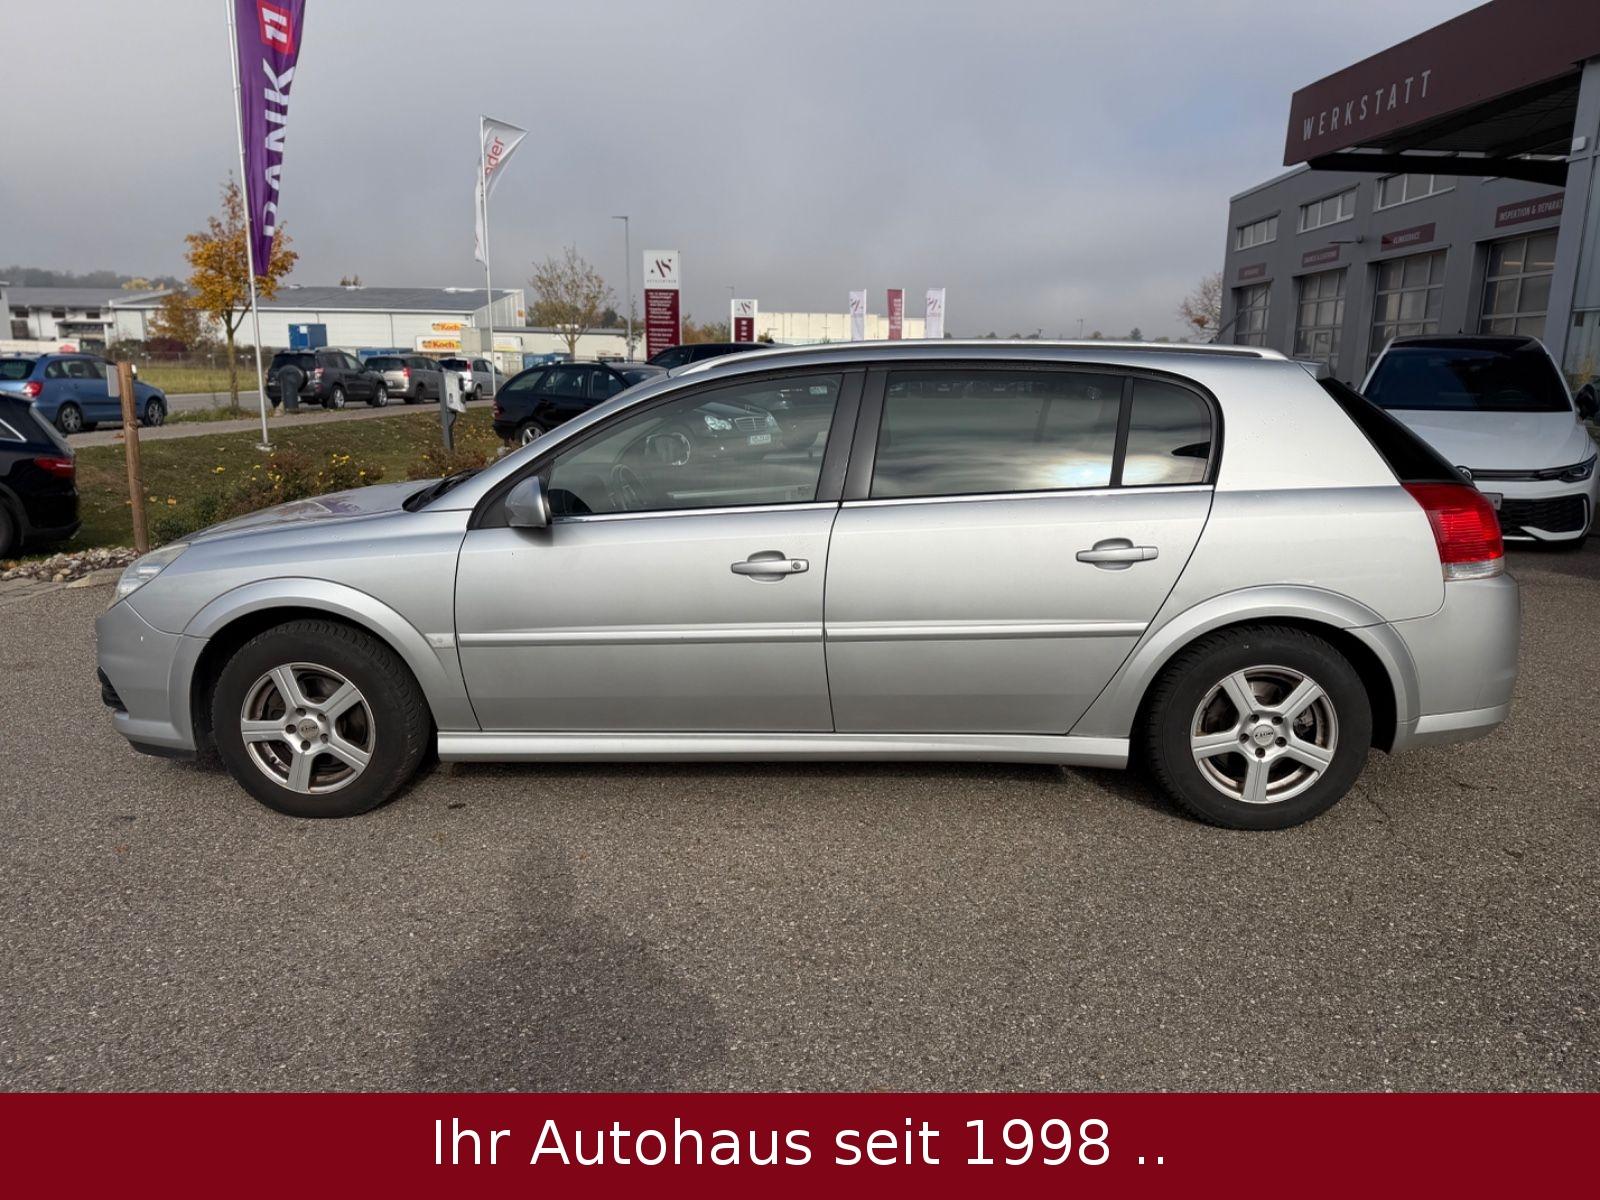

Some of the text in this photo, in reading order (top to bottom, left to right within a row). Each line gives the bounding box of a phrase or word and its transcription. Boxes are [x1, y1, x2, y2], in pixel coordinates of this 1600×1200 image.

[262, 7, 288, 44] 11
[1302, 69, 1432, 141] WERKSTATT
[432, 340, 456, 348] Koch
